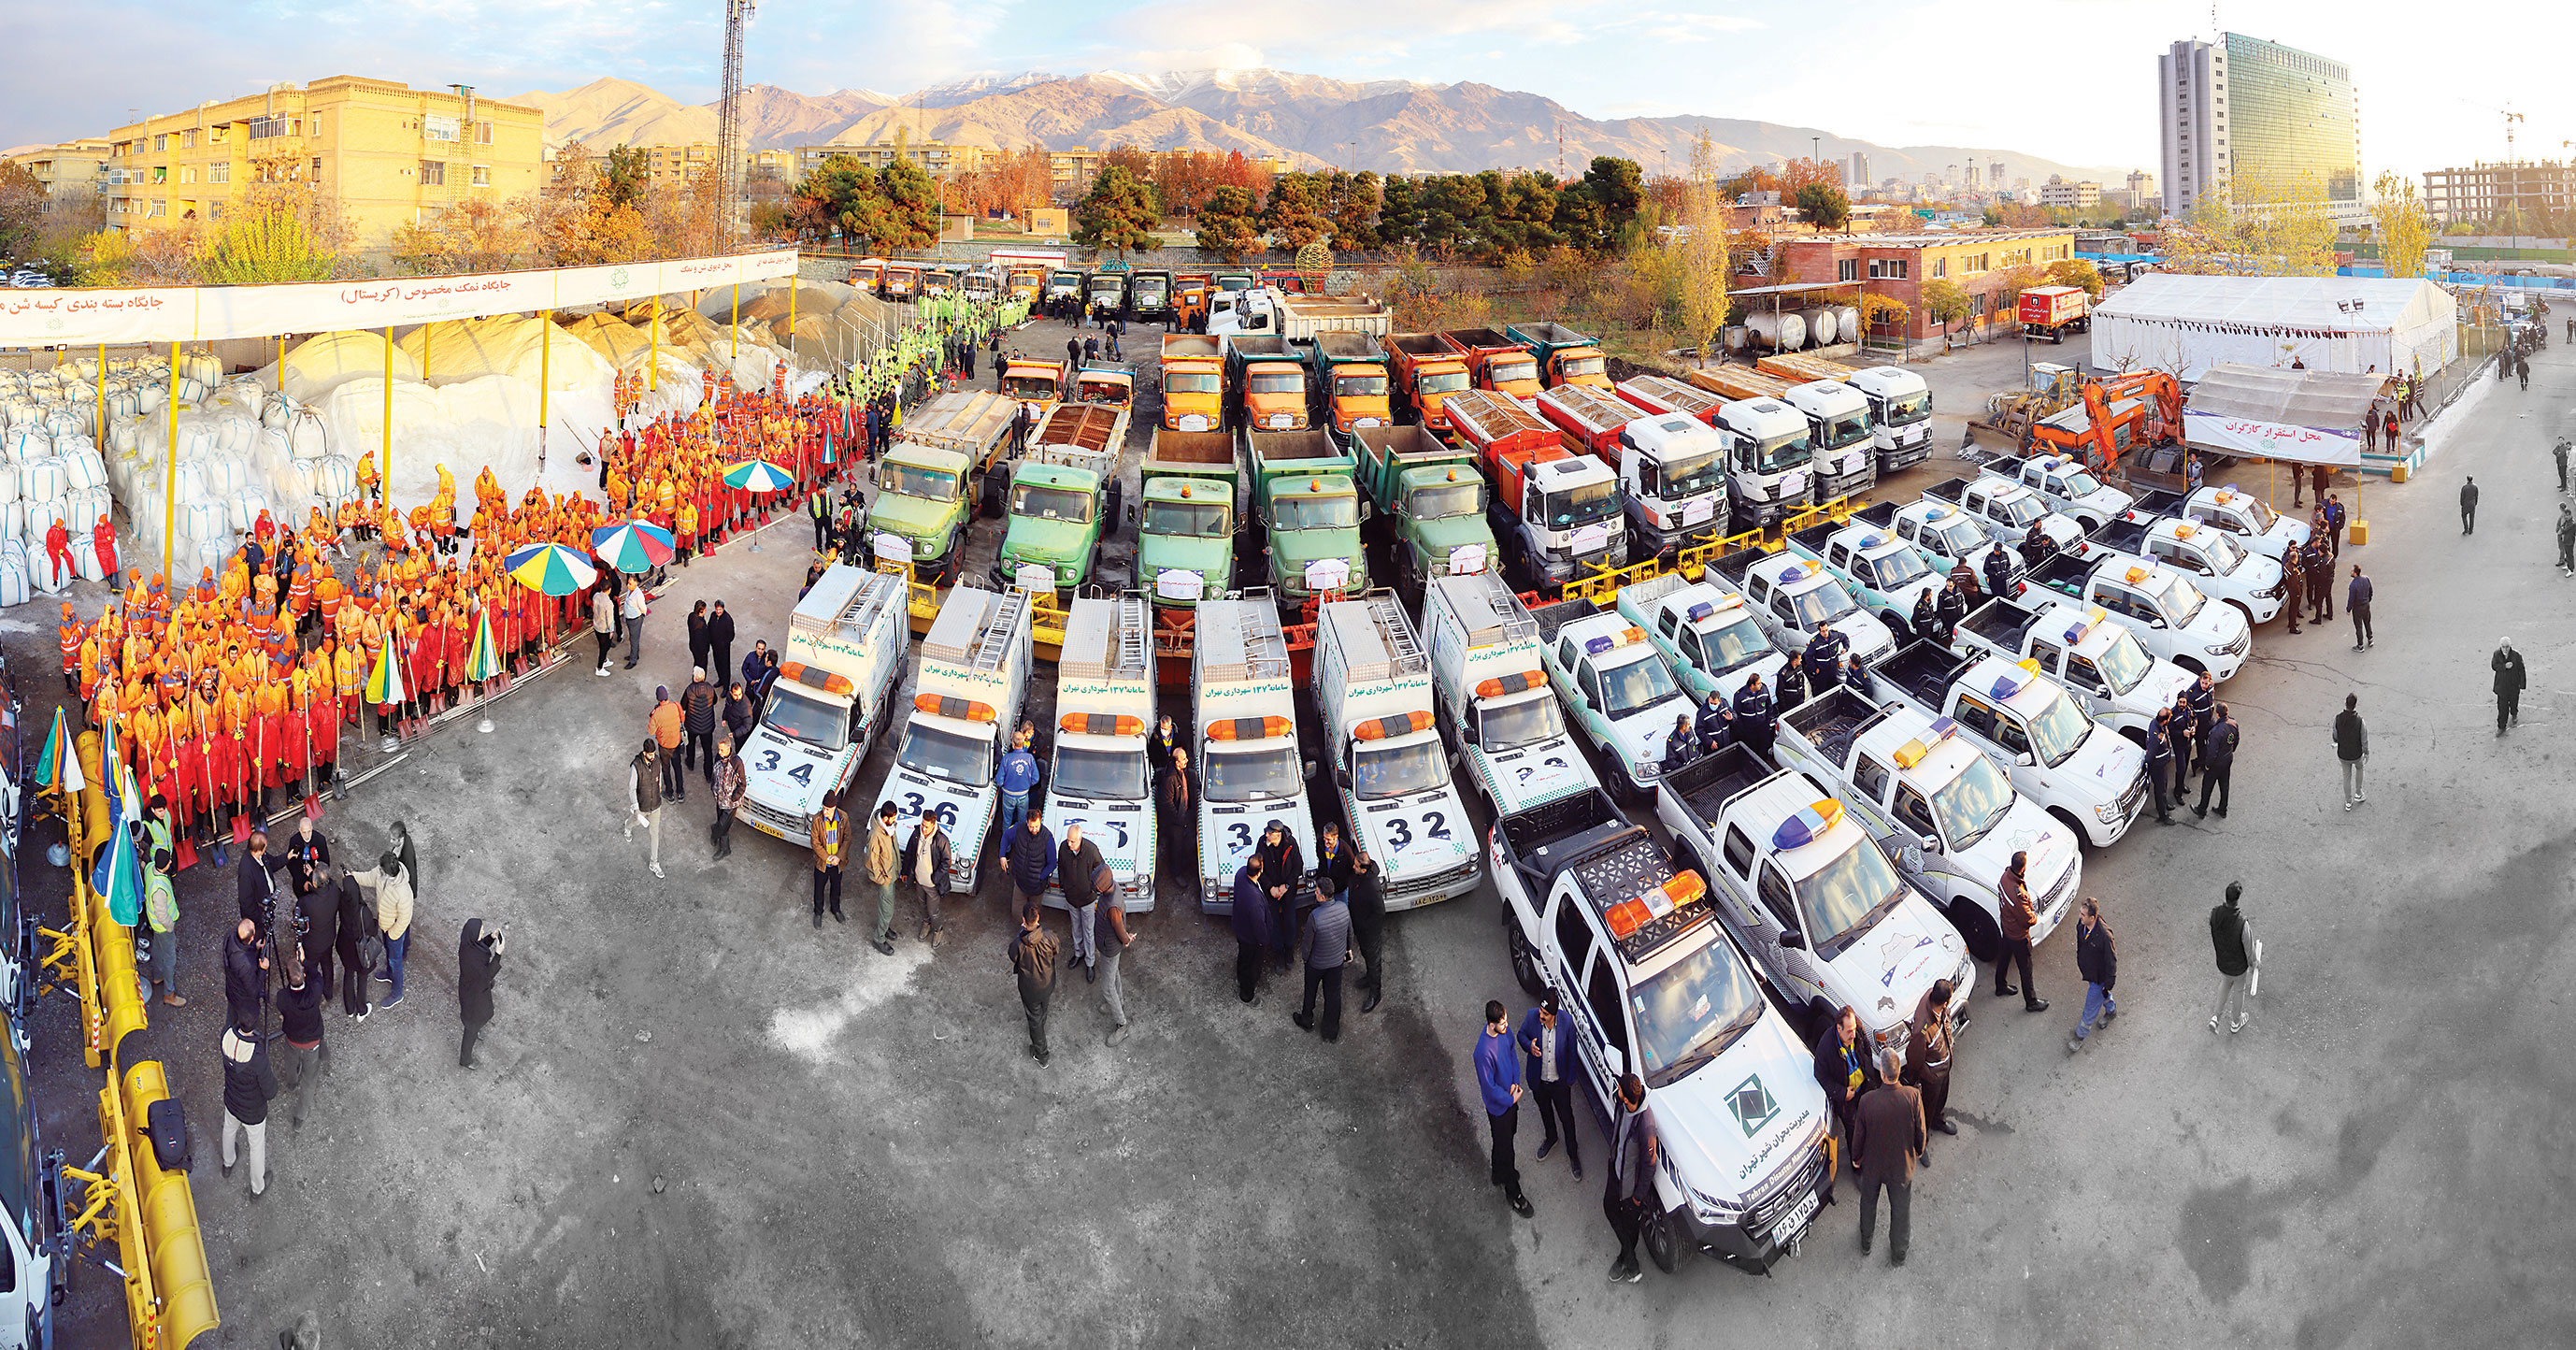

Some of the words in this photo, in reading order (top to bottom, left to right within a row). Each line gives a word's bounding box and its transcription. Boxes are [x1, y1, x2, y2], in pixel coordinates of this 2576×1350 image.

[405, 284, 452, 300] مخصوص
[455, 282, 479, 293] نمک
[482, 280, 511, 292] جایگاه
[9, 298, 31, 315] شن
[35, 297, 64, 313] کیسه
[67, 300, 98, 313] بندی
[102, 298, 124, 312] بسته
[127, 295, 164, 310] جایگاه
[2123, 384, 2144, 397] DOOSAN
[2225, 422, 2261, 437] کارگران
[2265, 427, 2297, 441] استقرار
[2298, 430, 2322, 443] محل
[792, 635, 807, 643] تهران
[1482, 648, 1506, 660] شهرداری
[924, 665, 940, 674] تهران
[942, 669, 968, 679] شهرداری
[1063, 684, 1080, 693] تهران
[1080, 685, 1108, 694] شهرداری
[1366, 683, 1393, 696] شهرداری
[1410, 680, 1428, 688] سامانه
[1205, 688, 1223, 697] تهران
[1224, 686, 1252, 697] شهرداری
[1348, 687, 1366, 697] تهران
[755, 750, 814, 783] 34
[898, 792, 959, 826] 36
[1386, 811, 1451, 845] 32
[1555, 975, 1568, 1000] تهران
[1567, 1002, 1579, 1021] شهر
[1578, 1020, 1592, 1049] بحران
[1591, 1046, 1610, 1082] مدیریت
[1789, 1110, 1810, 1131] مدیریت
[1772, 1127, 1791, 1148] بحران
[1760, 1142, 1773, 1162] شهر
[1739, 1154, 1758, 1181] تهران
[1746, 1183, 1769, 1202] Tehran
[1768, 1163, 1793, 1185] Disaster
[1791, 1128, 1822, 1166] Management
